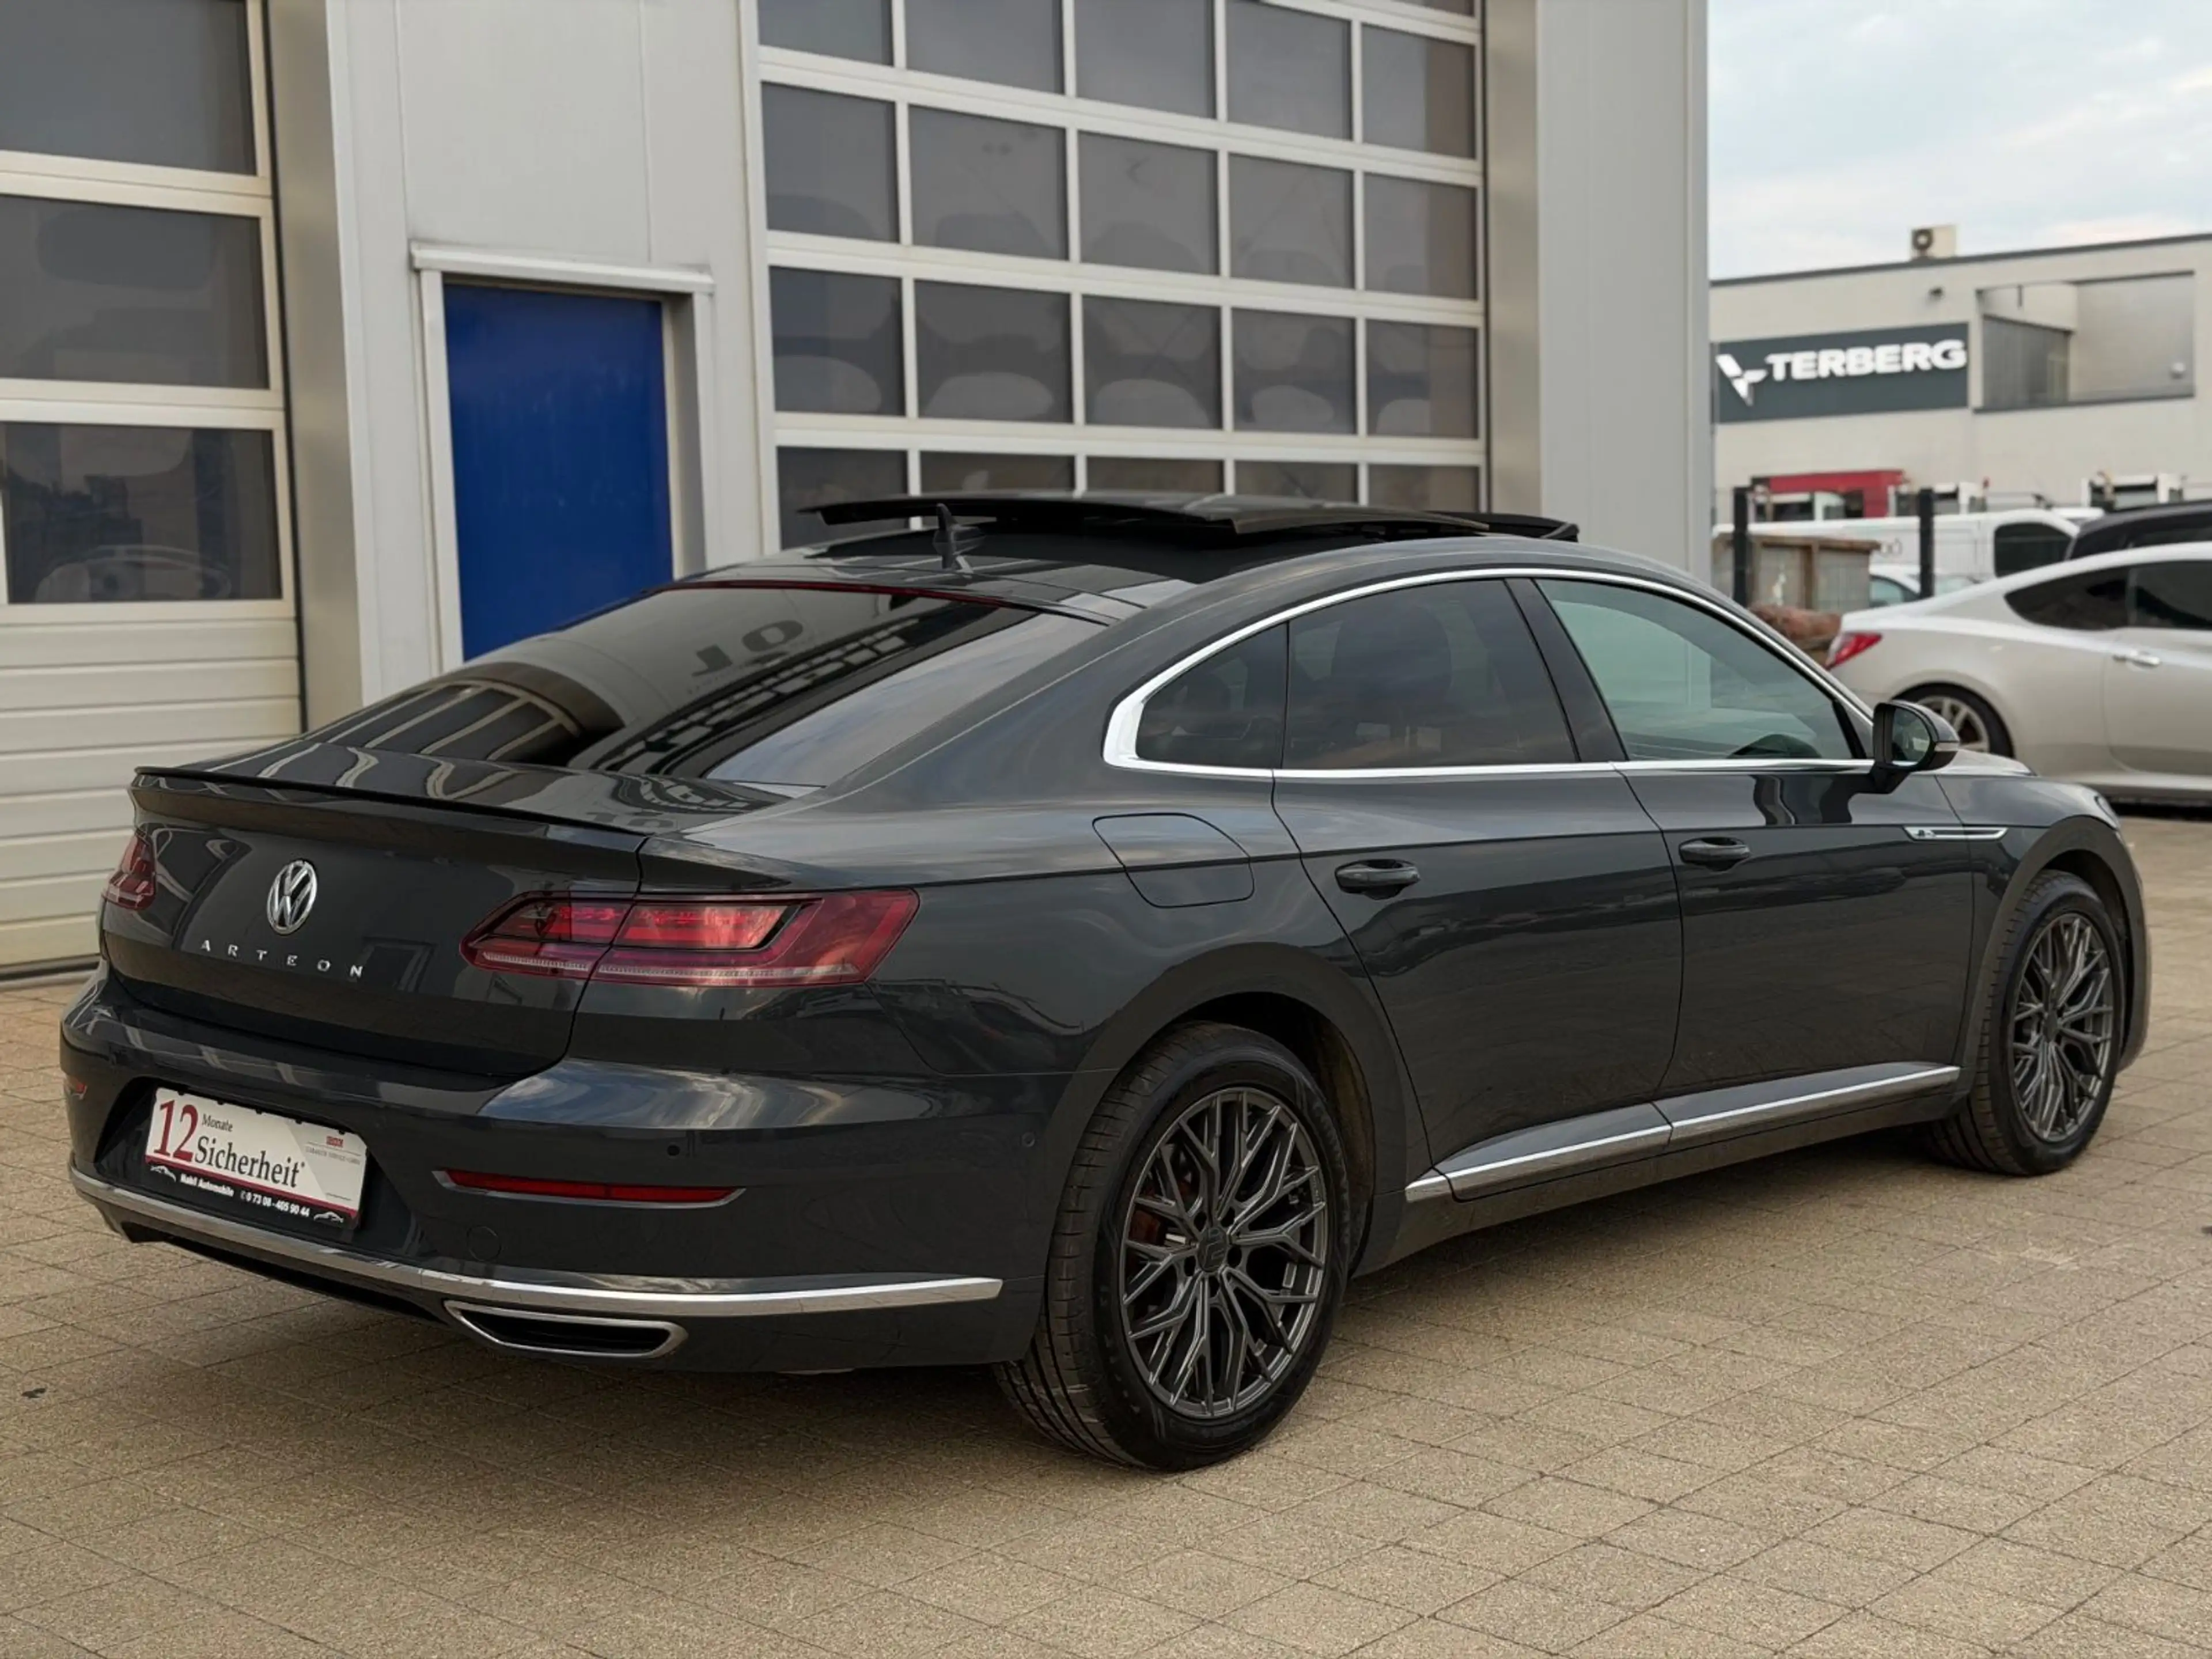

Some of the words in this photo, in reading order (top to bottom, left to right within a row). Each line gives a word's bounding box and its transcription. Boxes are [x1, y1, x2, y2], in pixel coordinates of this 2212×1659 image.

[1765, 339, 1967, 381] TERBERG
[267, 860, 317, 934] VW
[201, 940, 363, 978] ARTEON
[153, 1099, 199, 1162] 12
[202, 1113, 233, 1132] Monate
